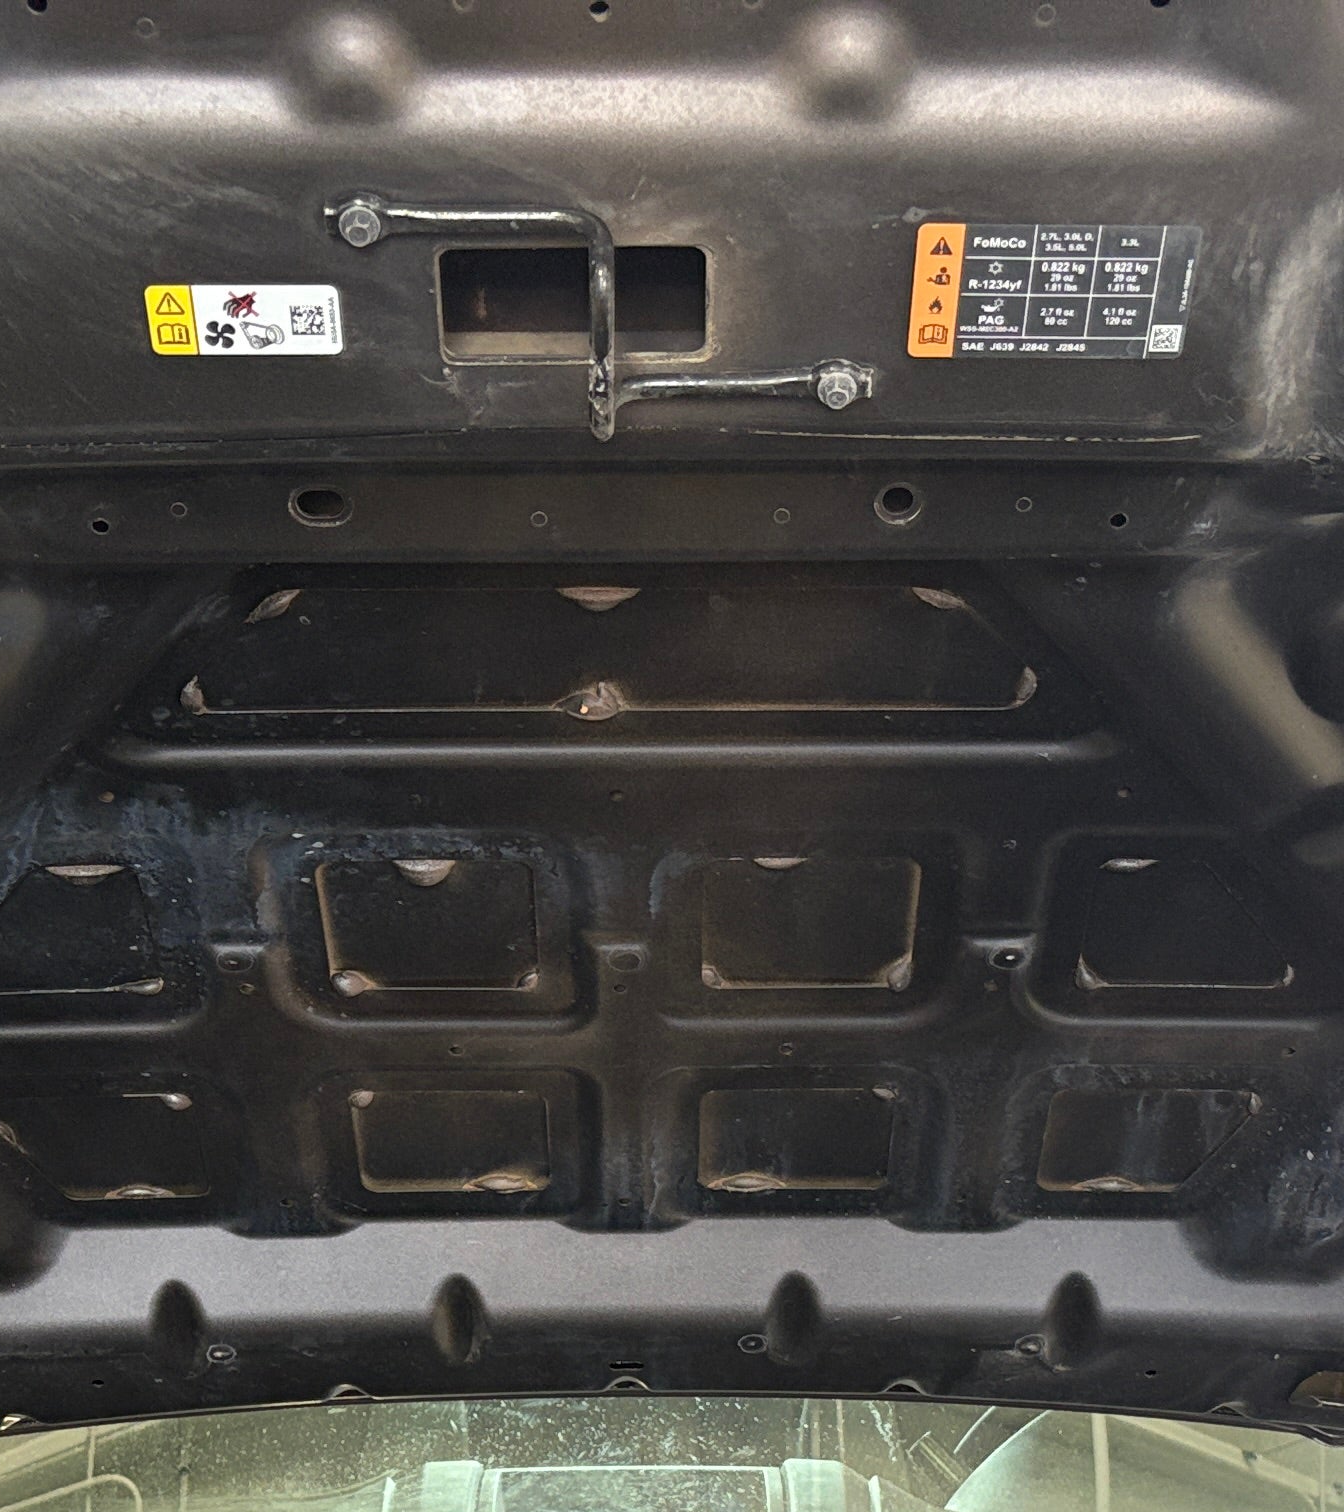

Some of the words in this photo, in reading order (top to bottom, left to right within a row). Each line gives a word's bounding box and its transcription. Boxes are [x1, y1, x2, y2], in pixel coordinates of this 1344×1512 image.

[973, 236, 1027, 249] FoMoCo
[1041, 261, 1070, 273] 0.822
[1071, 262, 1086, 275] kg
[1104, 261, 1133, 273] 0.822
[1135, 261, 1149, 275] kg
[1113, 273, 1125, 283] 29
[1125, 275, 1138, 283] oz
[968, 279, 1023, 292] R-1234yf
[1126, 284, 1141, 293] lbs
[977, 315, 1005, 326] PAG
[961, 342, 985, 351] SAE
